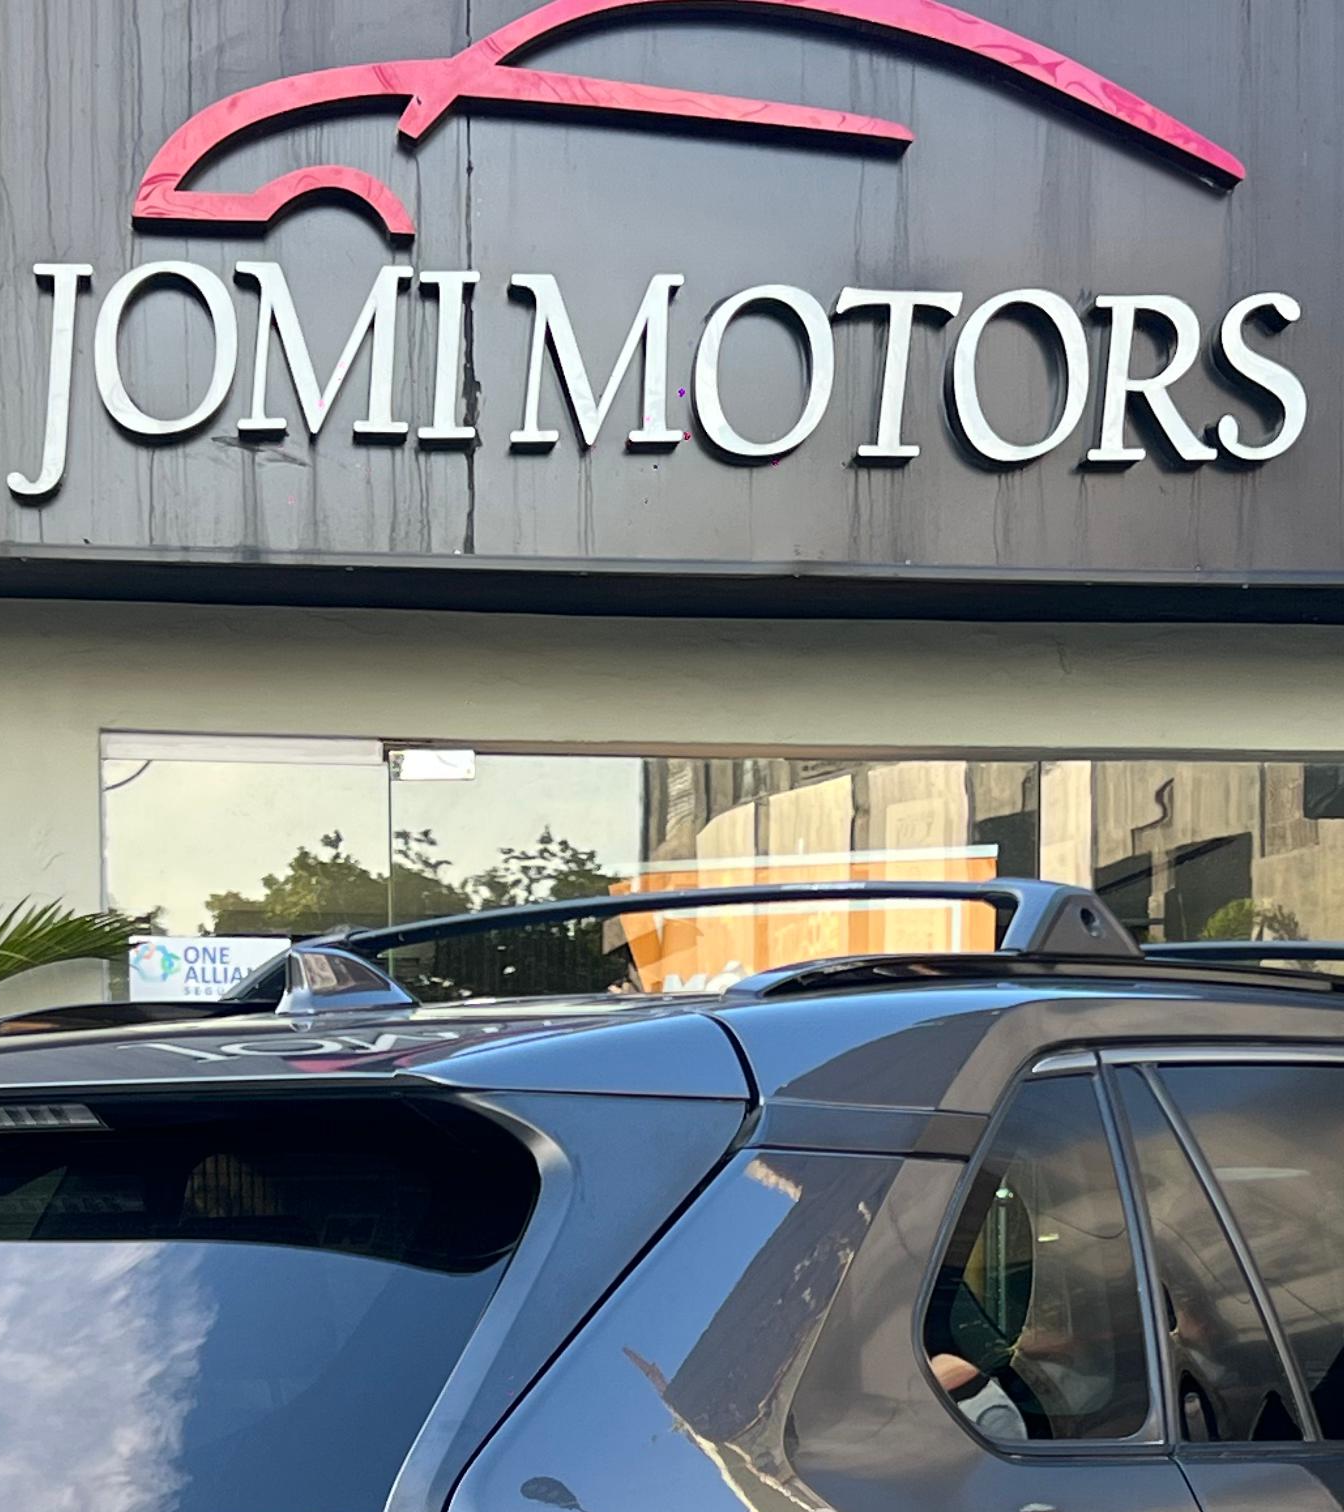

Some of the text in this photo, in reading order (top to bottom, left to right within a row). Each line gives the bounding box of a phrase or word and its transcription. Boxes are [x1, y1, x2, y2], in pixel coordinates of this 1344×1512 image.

[7, 260, 1308, 503] JOMI MOTORS
[183, 946, 231, 965] ONE
